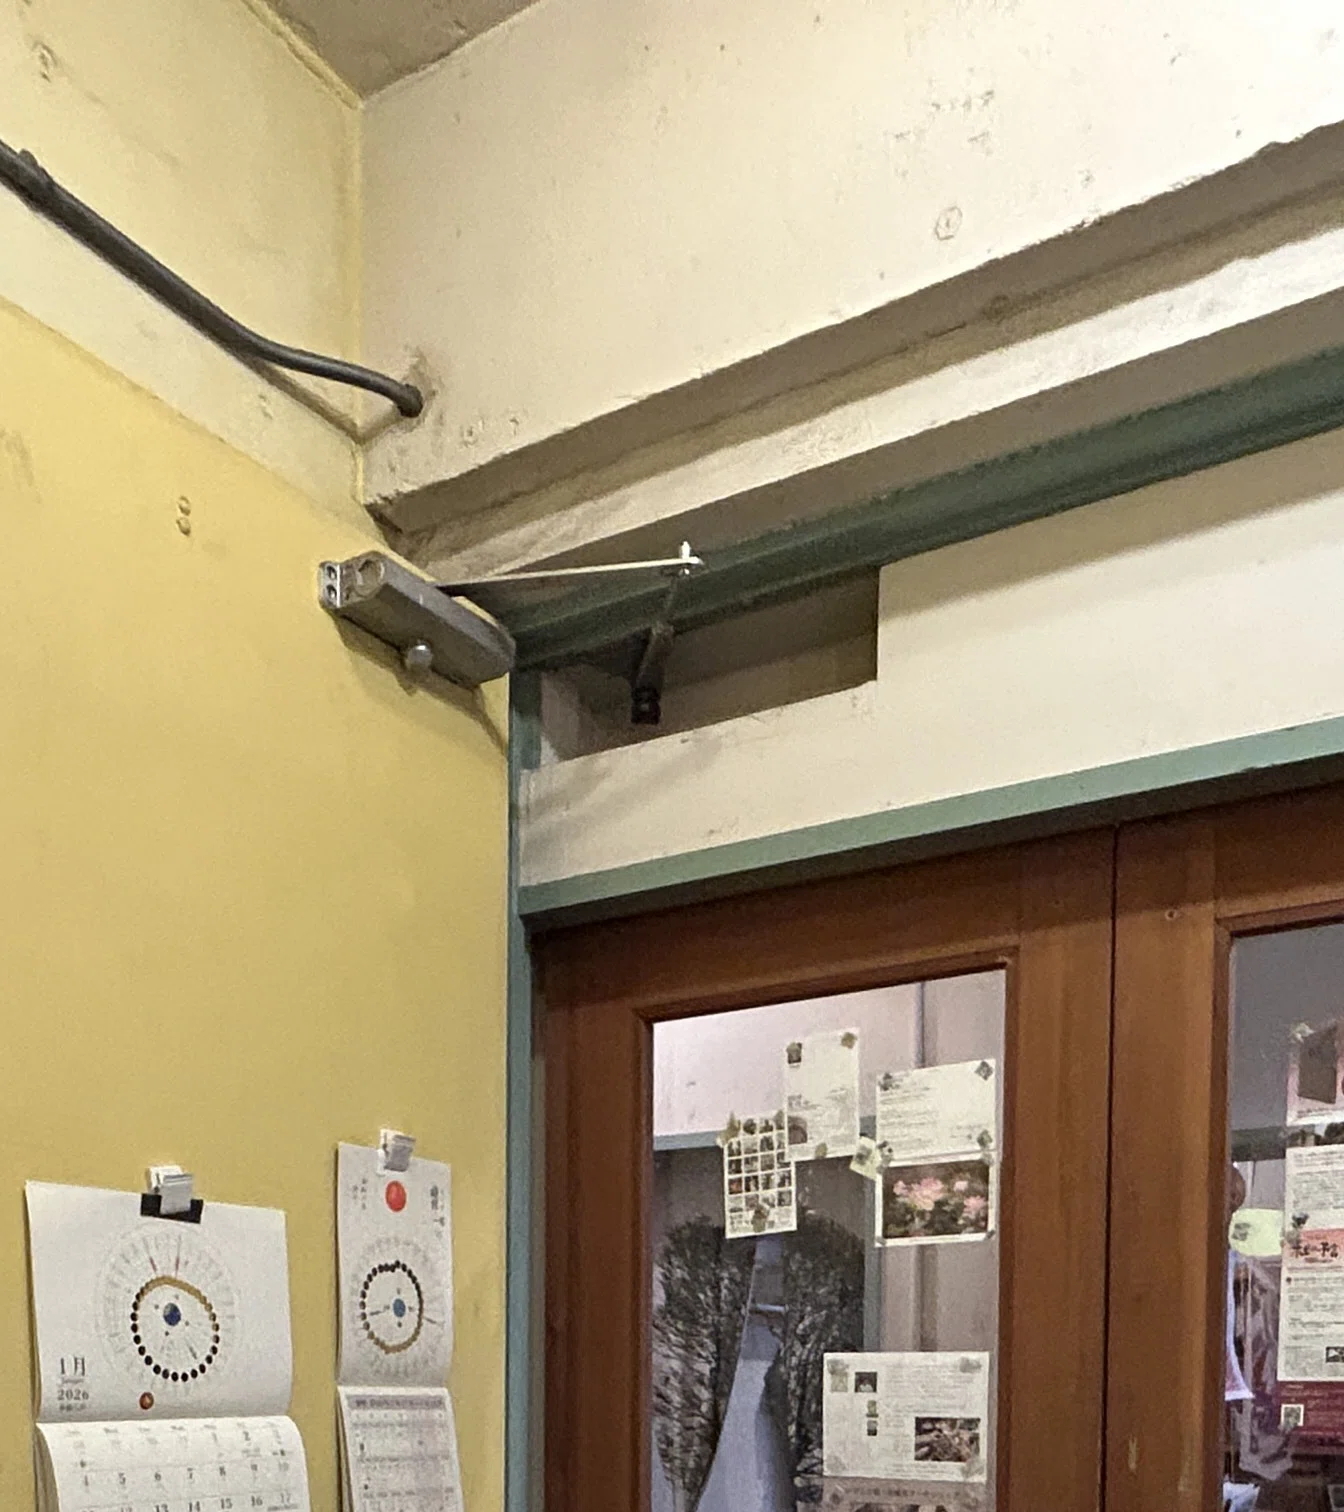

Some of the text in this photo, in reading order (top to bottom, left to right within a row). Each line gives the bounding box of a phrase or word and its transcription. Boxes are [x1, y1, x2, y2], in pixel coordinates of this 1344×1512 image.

[188, 1501, 201, 1512] 14
[220, 1498, 233, 1510] 15
[251, 1495, 263, 1507] 16
